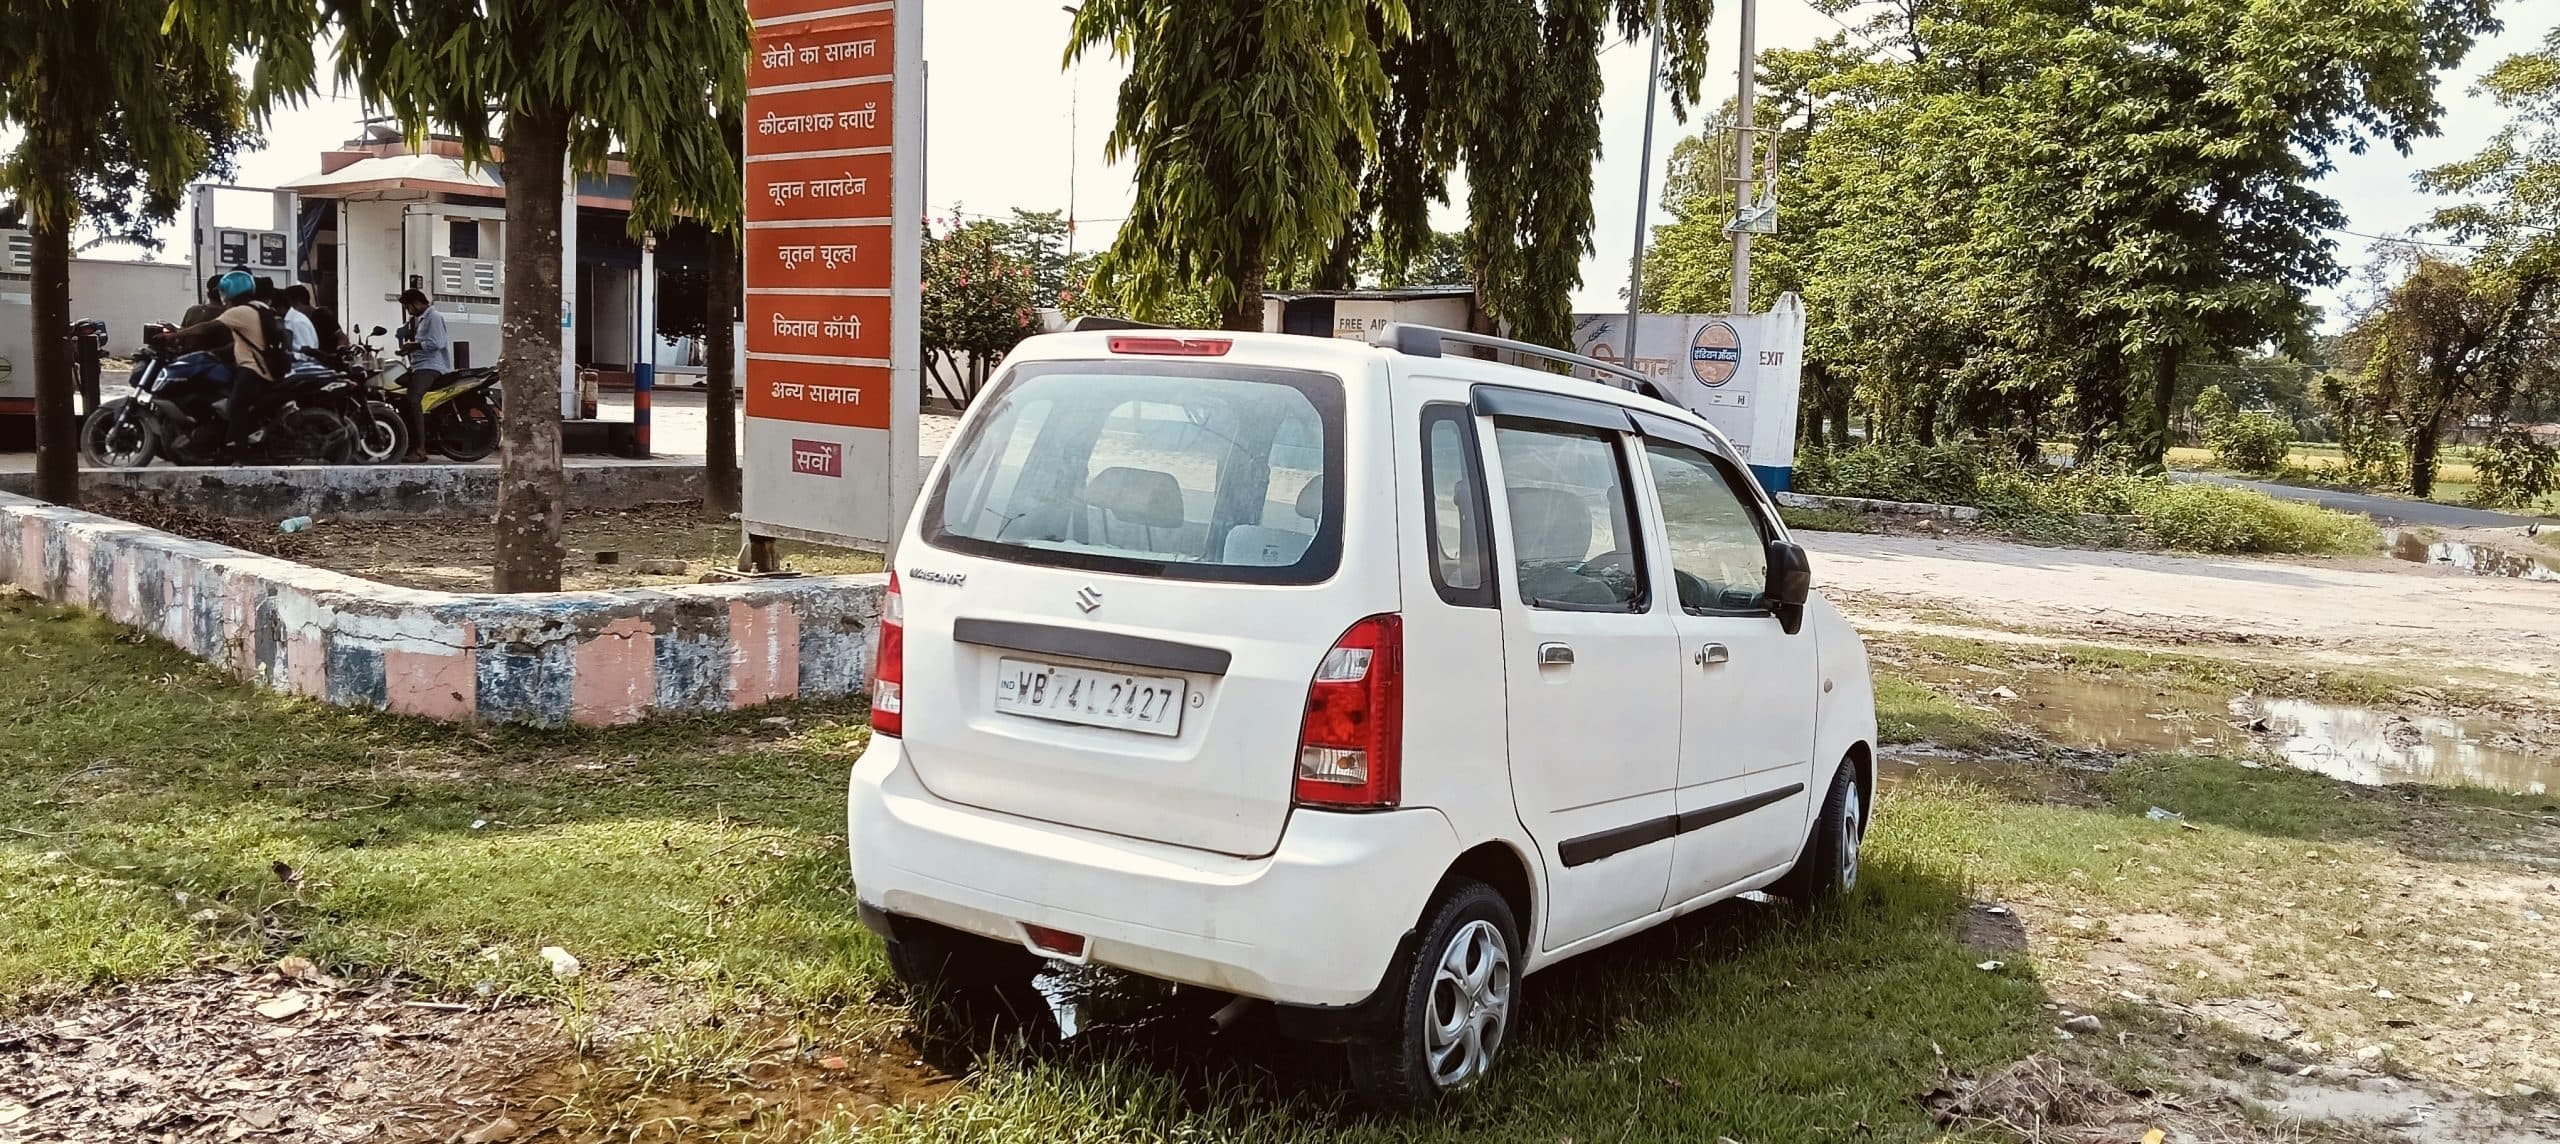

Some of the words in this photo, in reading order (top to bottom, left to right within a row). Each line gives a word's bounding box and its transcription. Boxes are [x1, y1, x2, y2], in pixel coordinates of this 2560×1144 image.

[762, 42, 795, 69] खेती
[799, 45, 820, 65] का
[824, 39, 876, 62] सामान
[758, 111, 834, 136] कीटनाशक
[838, 101, 876, 131] दवाएँ
[768, 180, 805, 207] नूतन
[810, 171, 867, 198] लालटेन
[778, 245, 815, 270] नूतन
[820, 244, 857, 270] चूल्हा
[773, 312, 819, 338] किताब
[824, 315, 861, 340] कॉपी
[1339, 318, 1363, 330] FREE
[1759, 350, 1785, 366] EXIT
[771, 381, 804, 401] अन्य
[809, 384, 861, 405] सामान
[795, 445, 832, 473] सर्वो
[1000, 679, 1016, 691] IND
